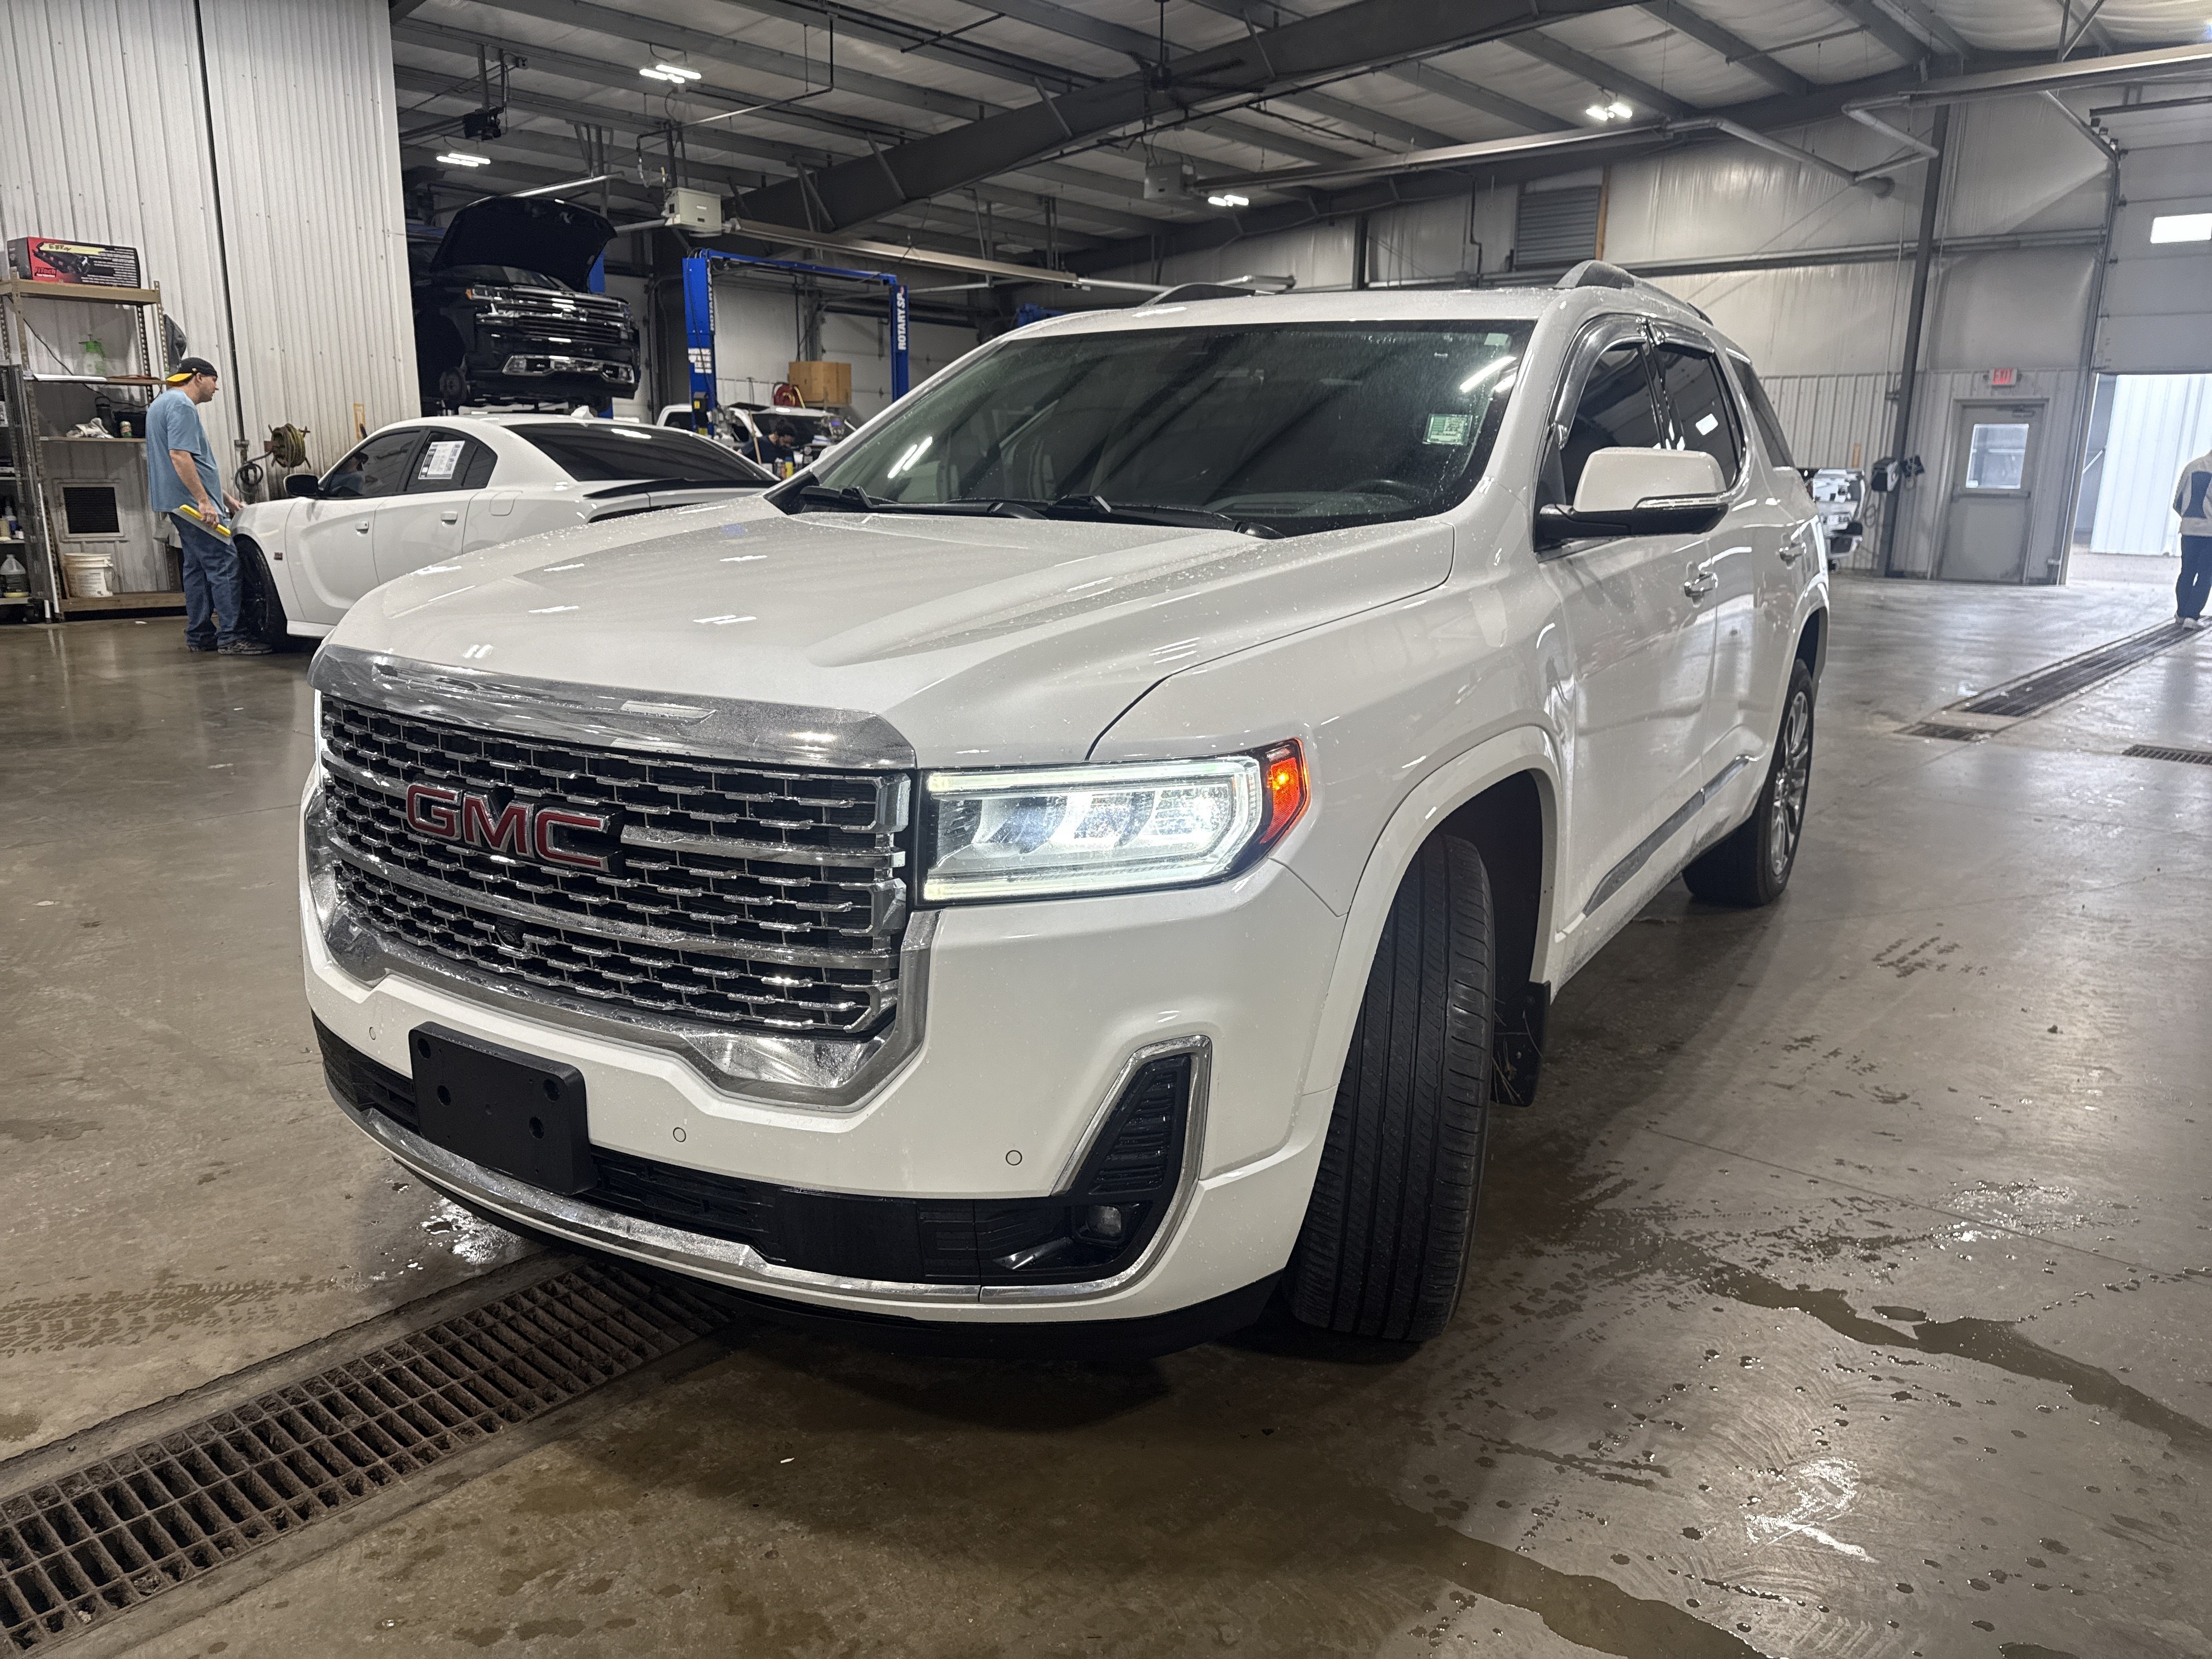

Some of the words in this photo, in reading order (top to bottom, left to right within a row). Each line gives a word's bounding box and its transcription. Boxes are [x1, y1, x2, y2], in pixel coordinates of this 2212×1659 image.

[897, 308, 906, 350] ROTARY
[1993, 368, 2013, 383] EXIT
[407, 781, 610, 872] GMC
